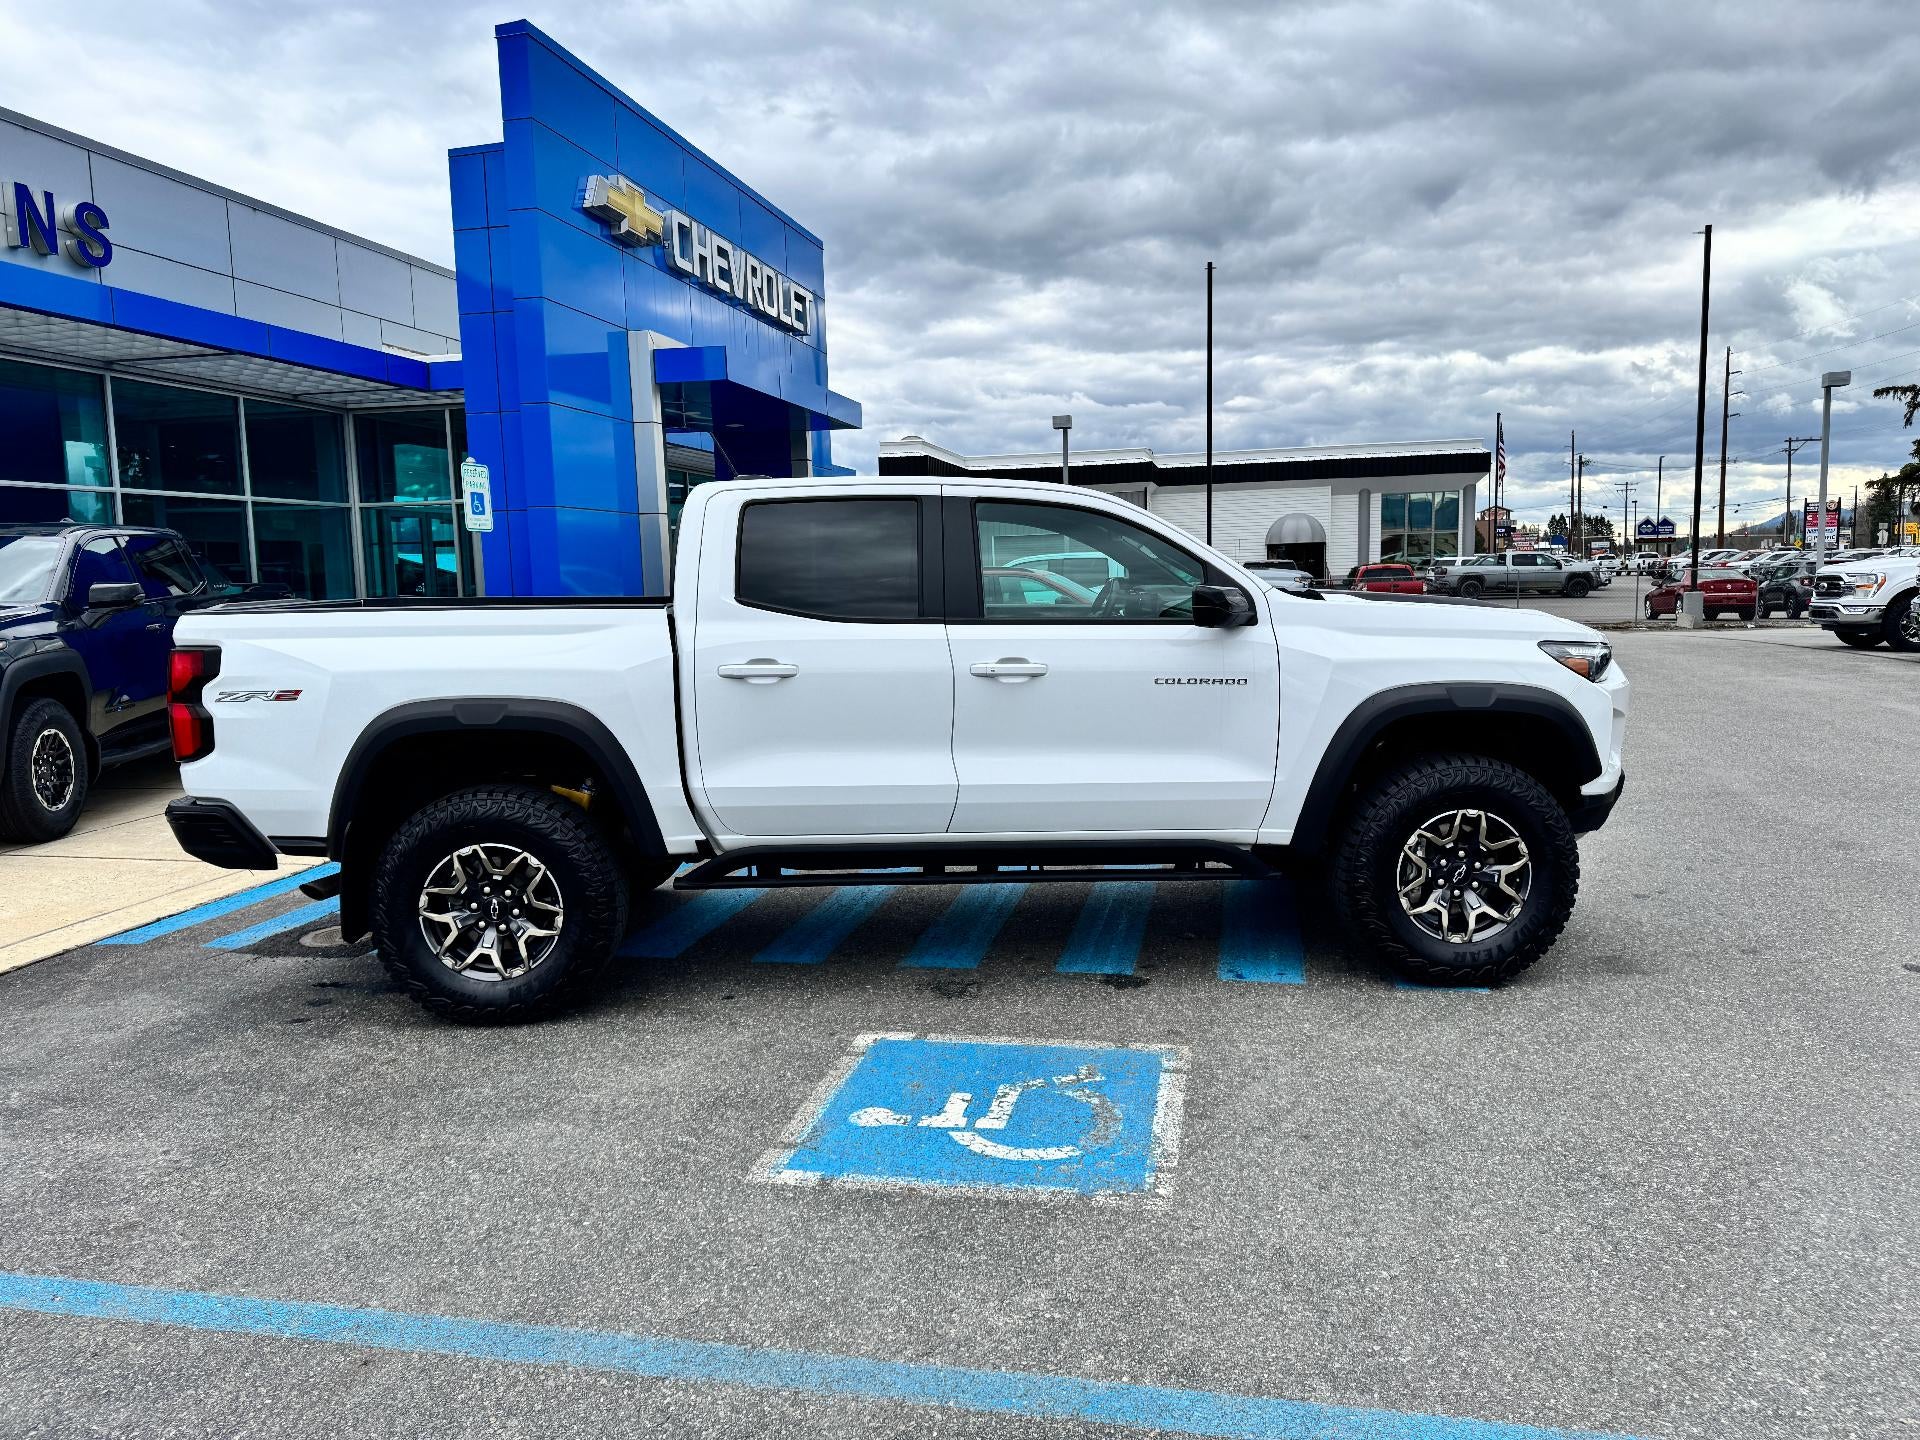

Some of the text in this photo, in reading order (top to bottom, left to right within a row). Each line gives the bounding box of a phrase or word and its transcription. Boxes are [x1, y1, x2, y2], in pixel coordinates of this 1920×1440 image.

[662, 209, 814, 336] CHEVROLET
[1153, 677, 1248, 686] COLORADO
[214, 689, 303, 703] ZR2
